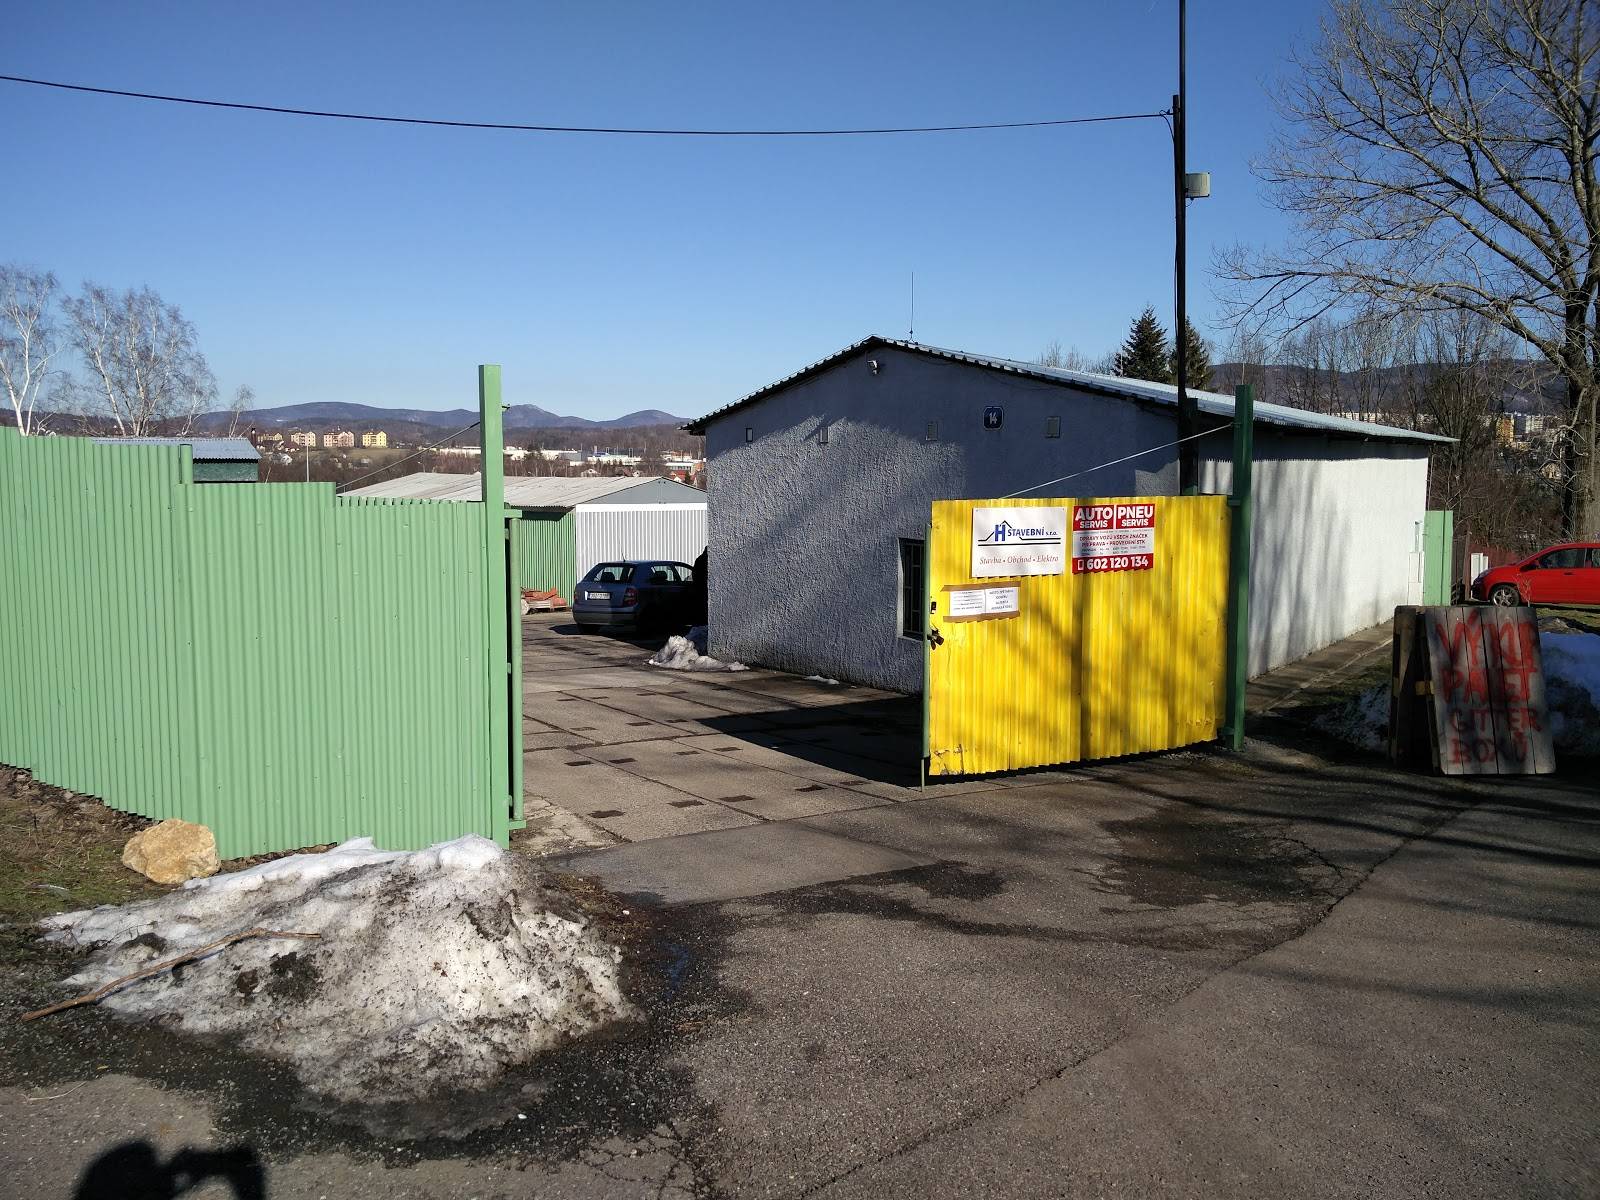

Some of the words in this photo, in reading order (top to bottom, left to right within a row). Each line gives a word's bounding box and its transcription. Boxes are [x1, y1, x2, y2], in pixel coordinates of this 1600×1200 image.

[1075, 507, 1113, 521] AUTO
[1117, 506, 1154, 519] PNEU
[1079, 520, 1108, 529] SERVIS
[1121, 518, 1149, 527] SERVIS
[1008, 527, 1045, 537] STAVEBNÍ
[979, 557, 1002, 565] Stavba
[1007, 555, 1032, 564] Obchod
[1037, 555, 1059, 563] Elektro
[1087, 558, 1108, 570] 602
[1110, 557, 1129, 569] 120
[1130, 555, 1149, 567] 134
[1440, 668, 1540, 706] PALET
